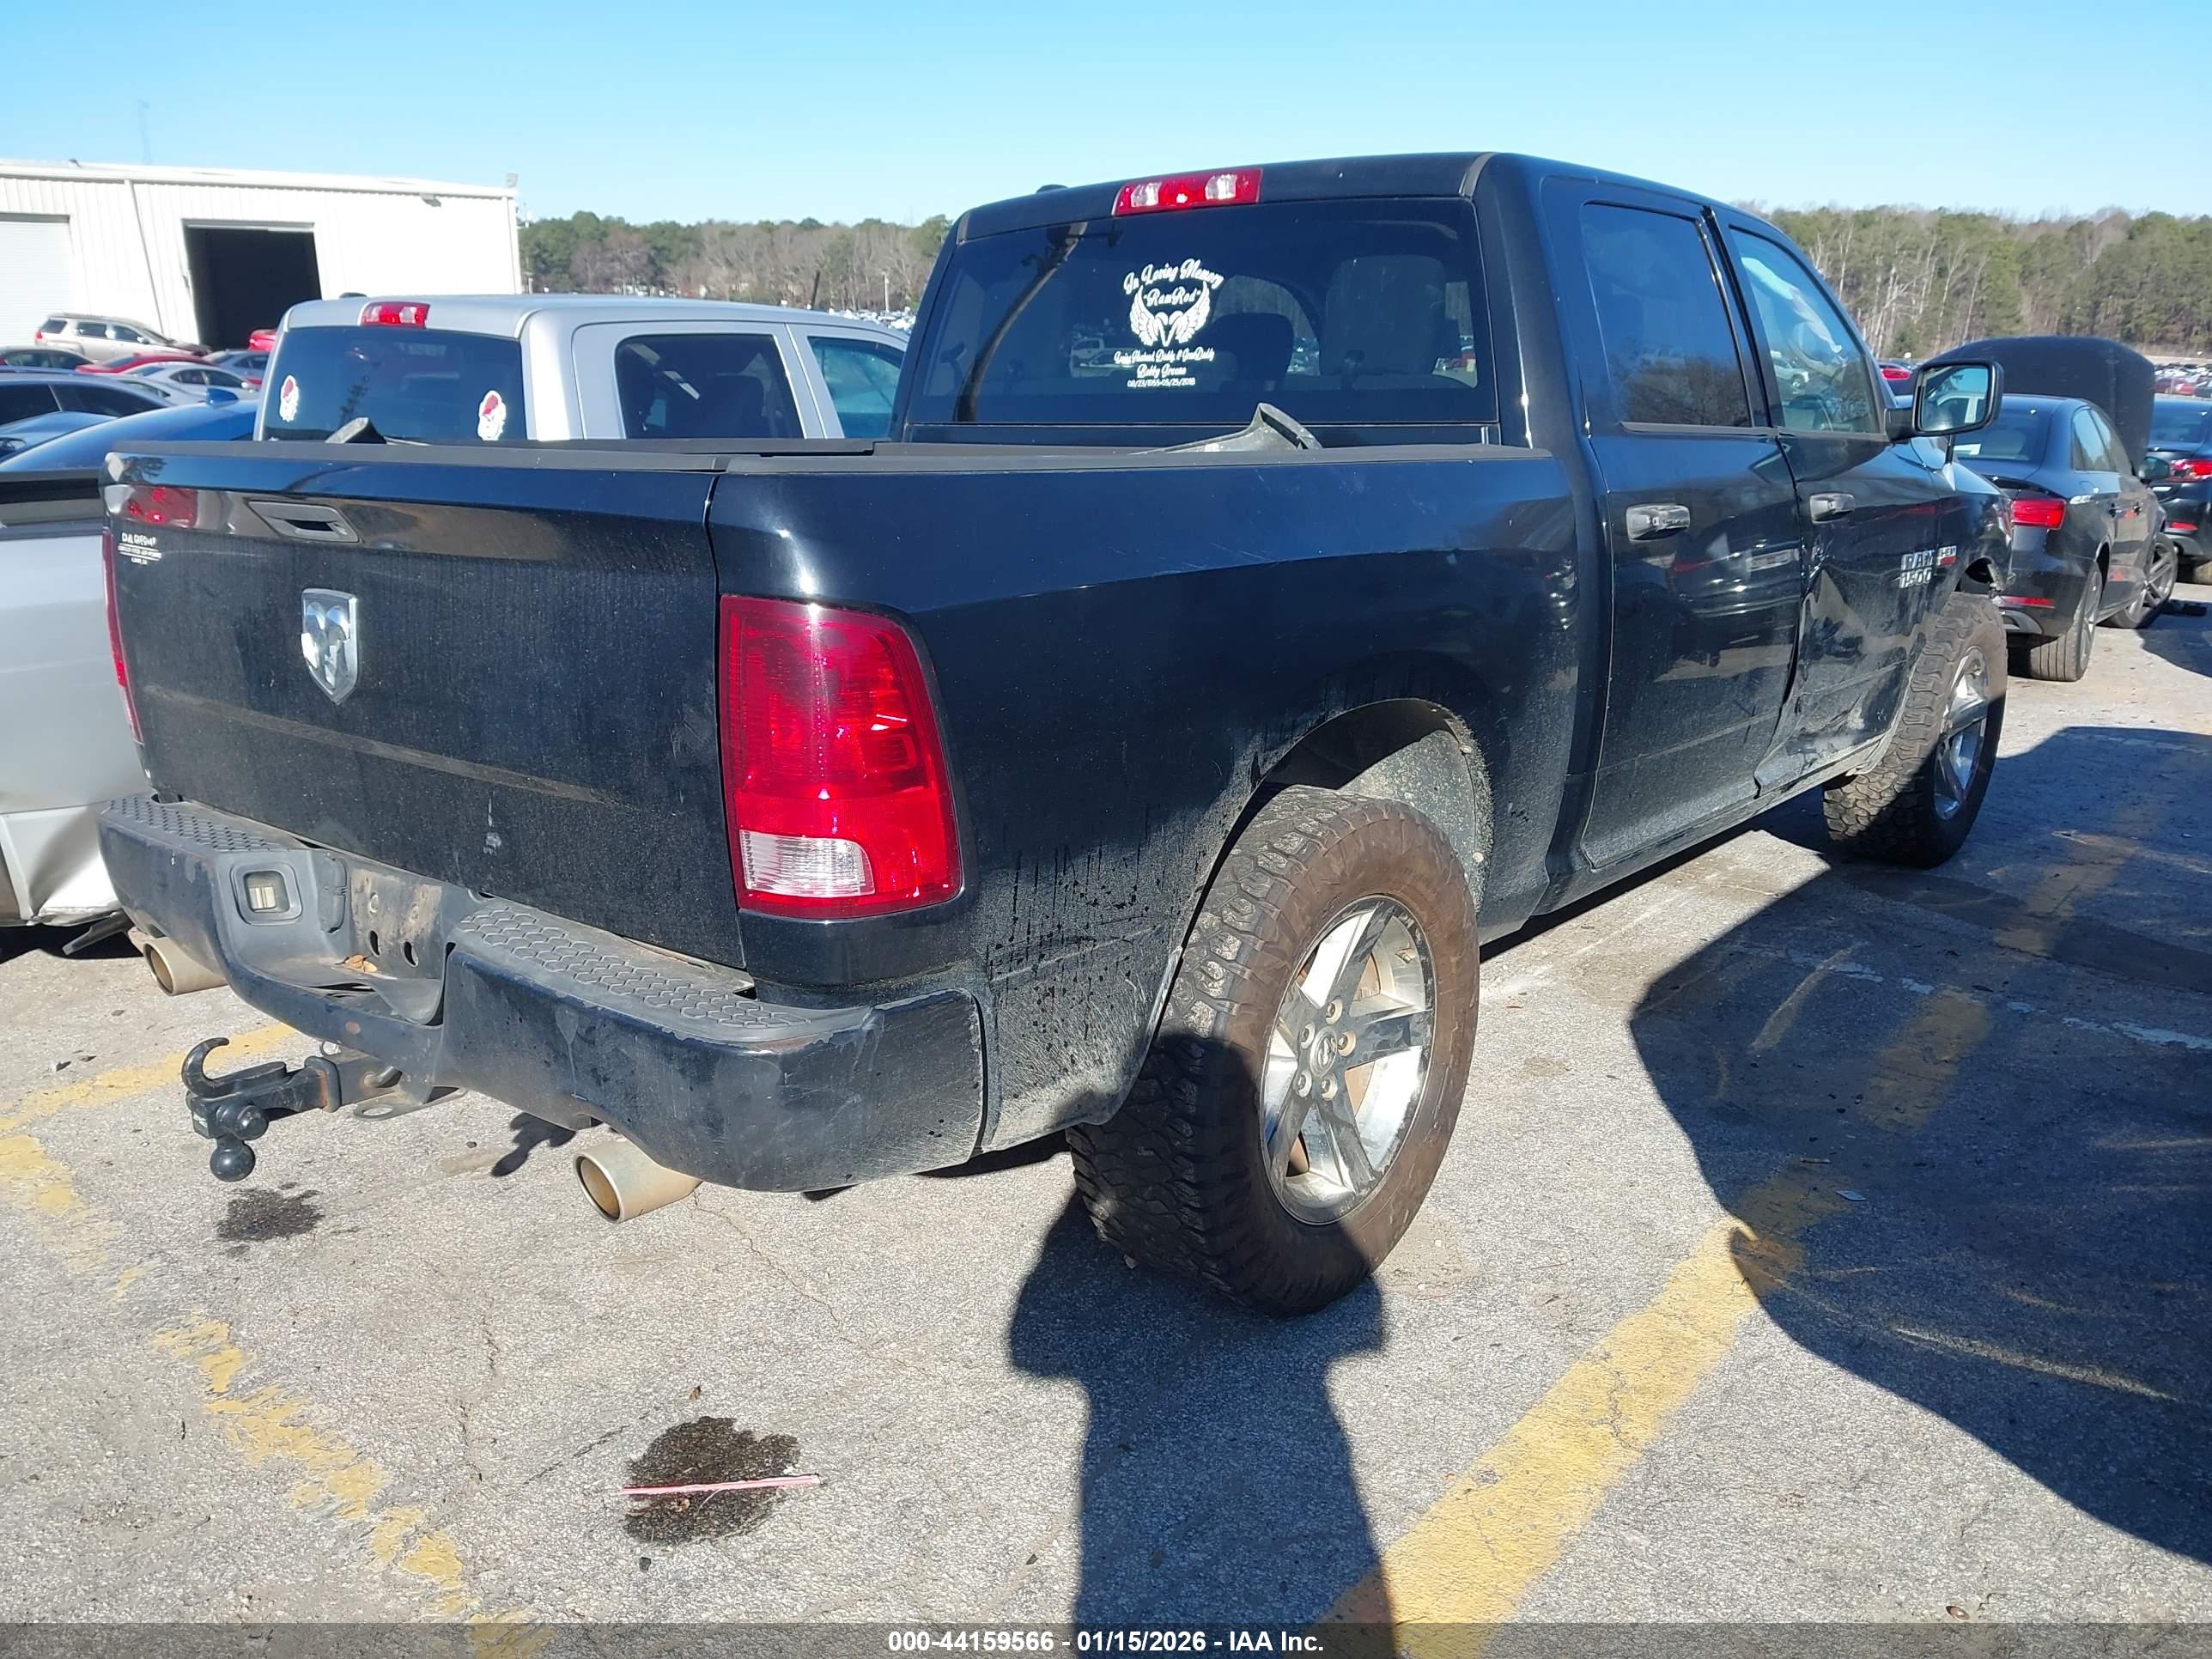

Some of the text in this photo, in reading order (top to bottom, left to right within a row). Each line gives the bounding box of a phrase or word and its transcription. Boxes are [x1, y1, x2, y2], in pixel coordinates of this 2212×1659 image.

[1123, 258, 1224, 295] In Loving Memory
[1137, 363, 1161, 379] Bobby
[1901, 550, 1936, 570] RAM
[1899, 567, 1932, 589] 1500
